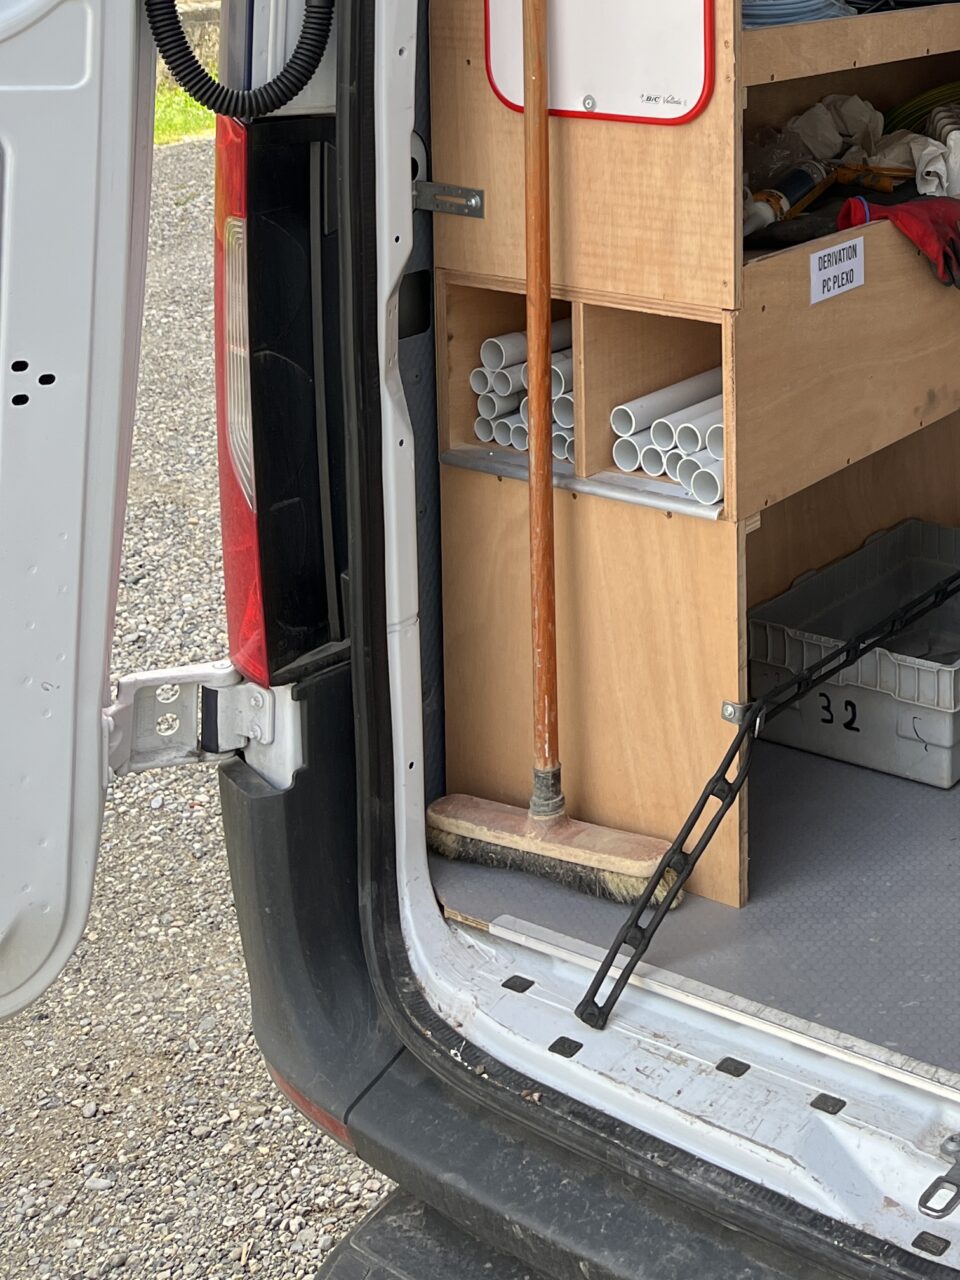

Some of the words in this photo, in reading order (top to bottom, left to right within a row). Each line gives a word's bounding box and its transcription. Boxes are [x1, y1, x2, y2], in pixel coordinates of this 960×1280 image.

[818, 243, 857, 271] DERIVATION
[822, 277, 831, 294] PC
[833, 268, 854, 290] PLEXO
[819, 693, 860, 732] 32
